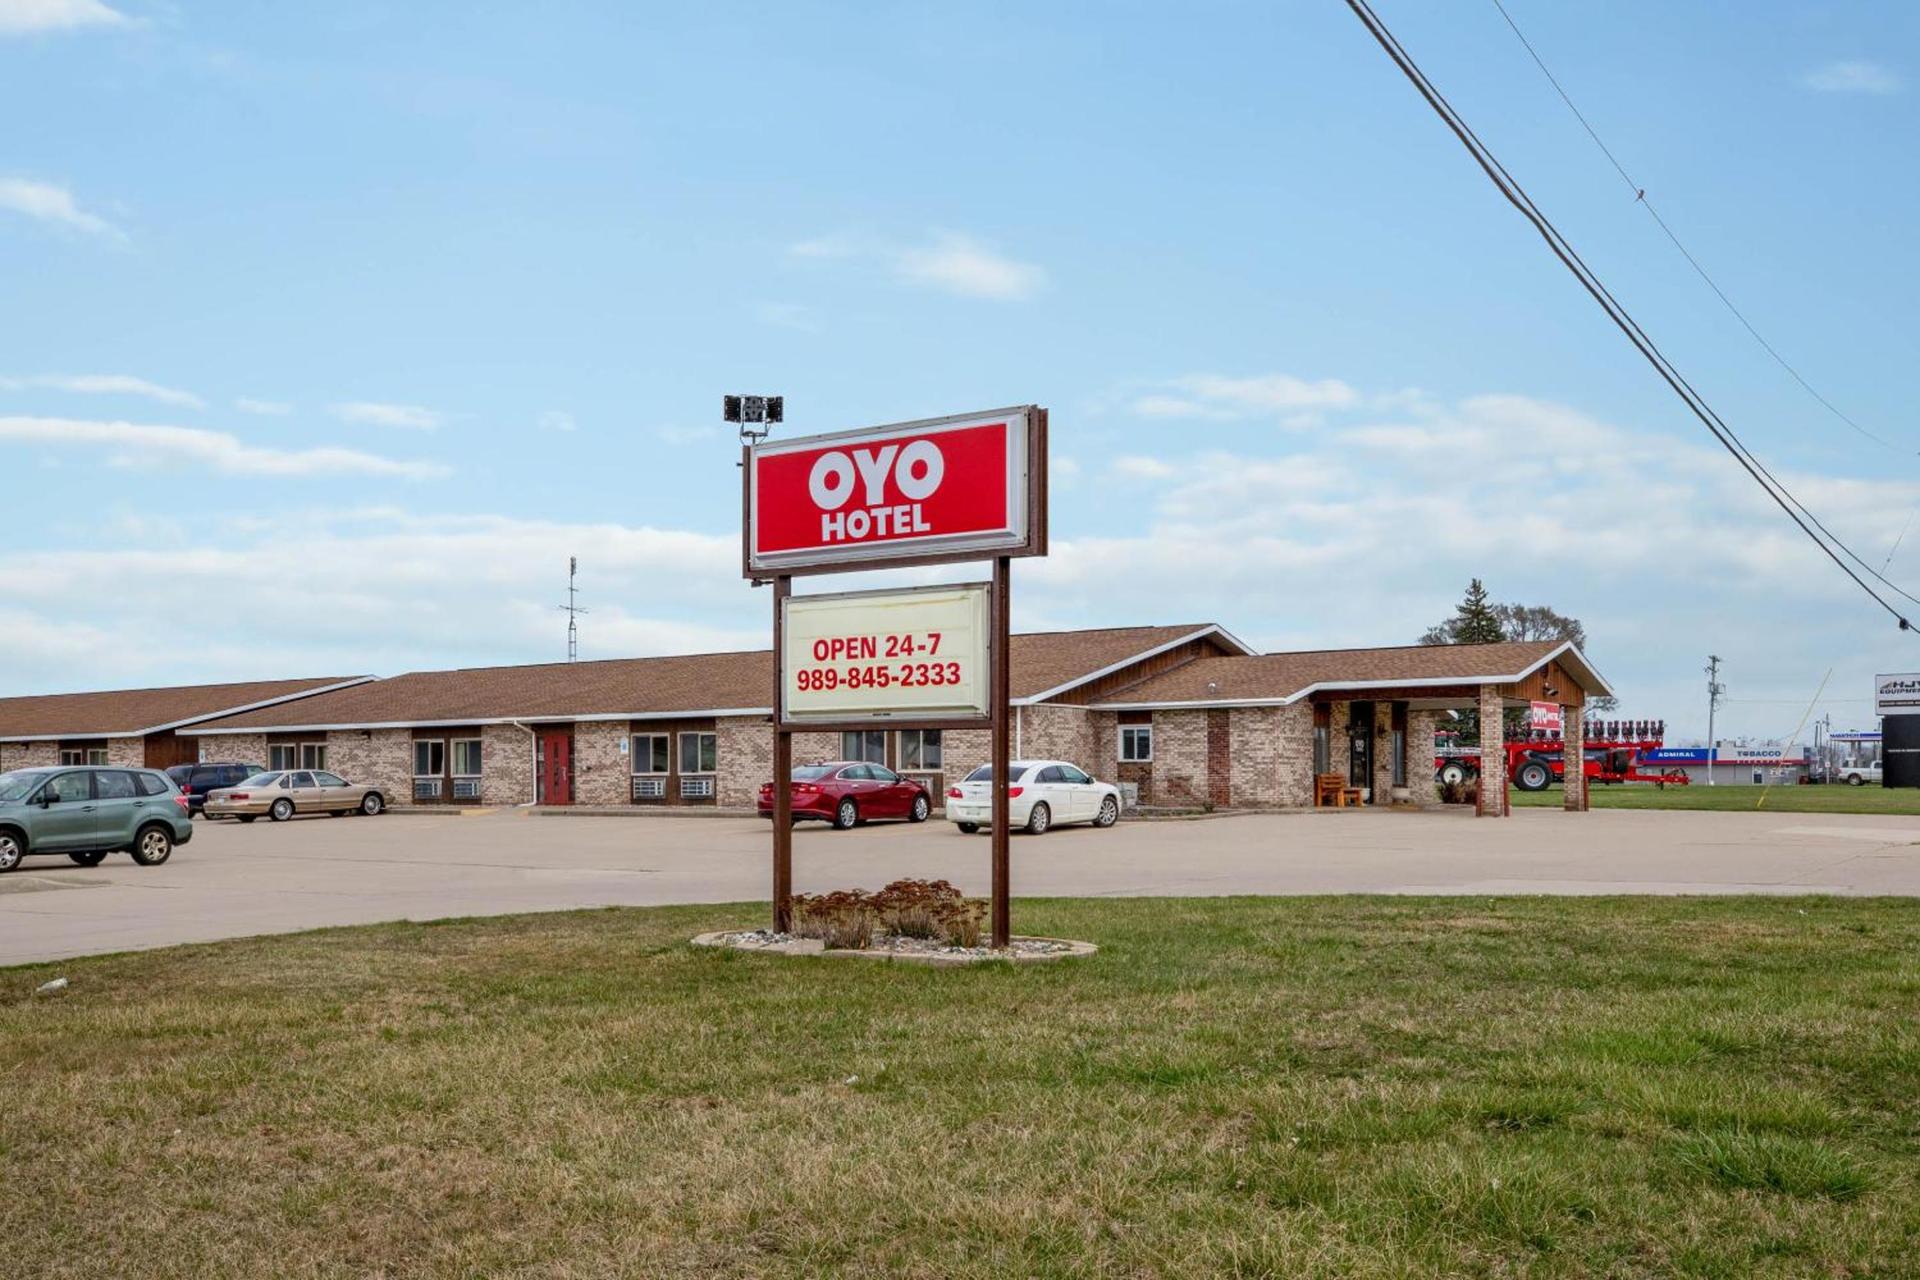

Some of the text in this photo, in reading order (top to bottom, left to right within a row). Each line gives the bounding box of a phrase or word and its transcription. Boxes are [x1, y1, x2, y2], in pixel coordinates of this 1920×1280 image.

[808, 440, 944, 510] OYO
[822, 503, 931, 541] HOTEL
[813, 633, 942, 661] OPEN 24-7
[797, 662, 961, 692] 989-845-2333
[1737, 750, 1781, 758] TOBACCO
